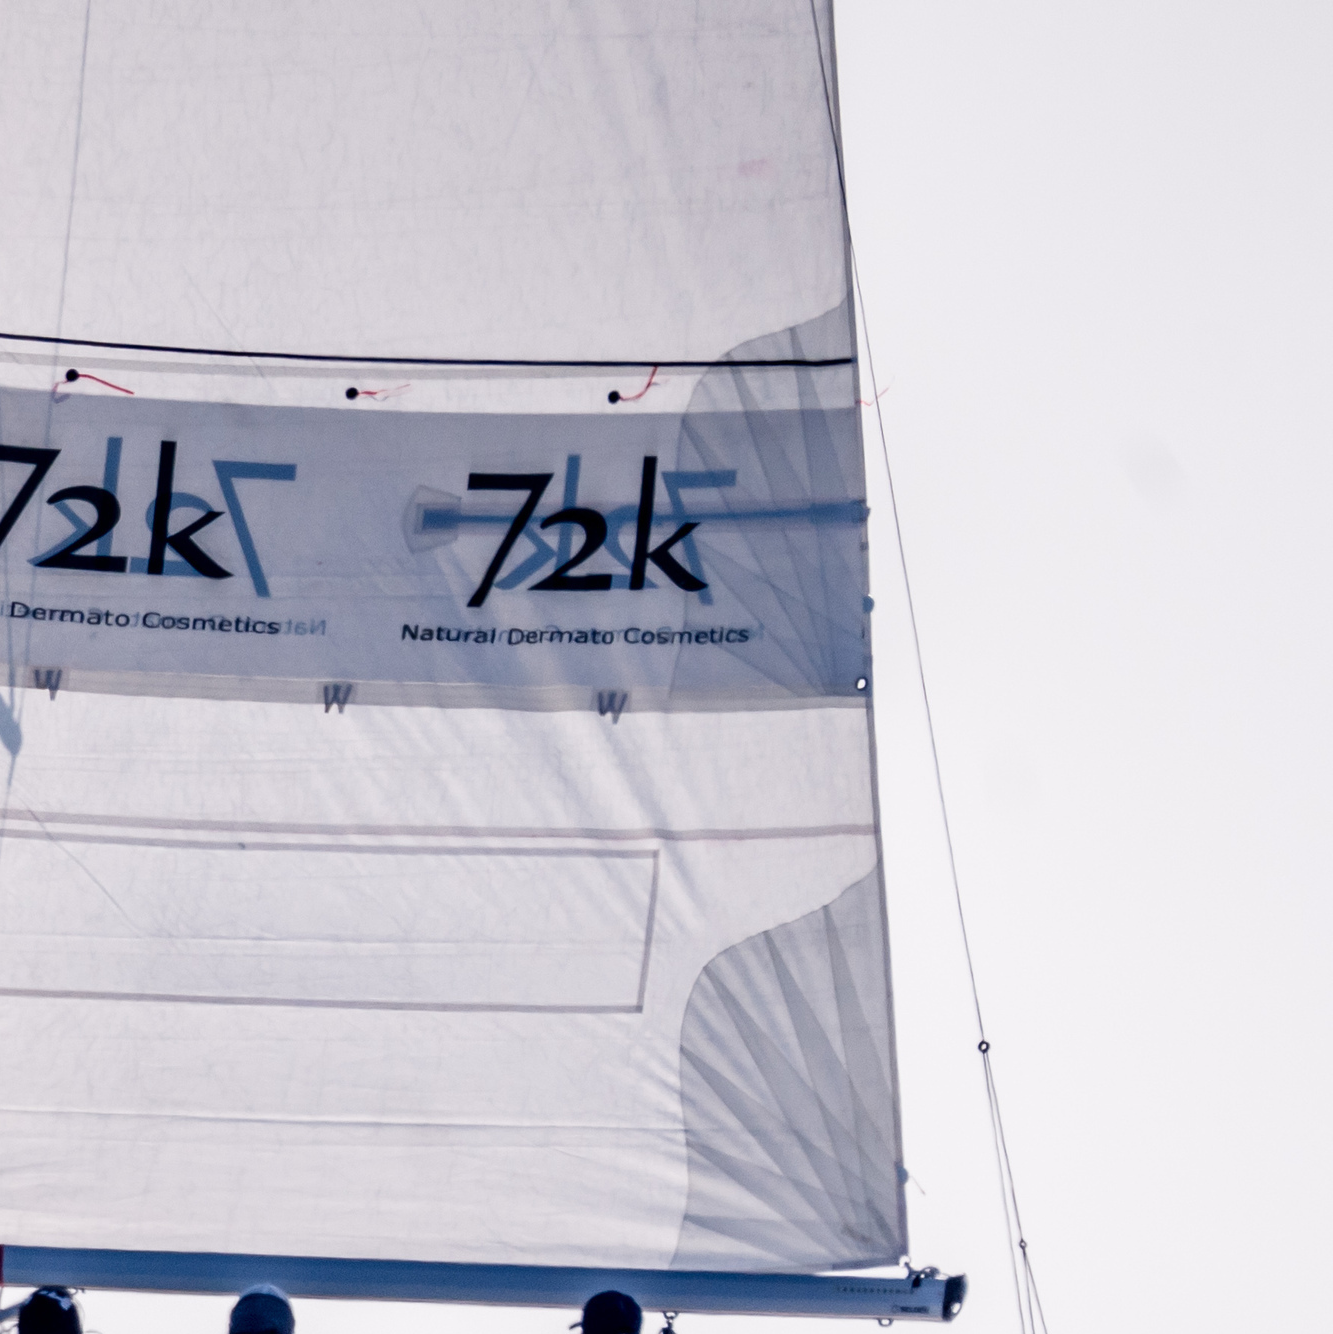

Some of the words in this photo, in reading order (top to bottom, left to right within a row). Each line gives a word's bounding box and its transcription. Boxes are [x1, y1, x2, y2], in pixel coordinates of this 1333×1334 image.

[466, 455, 709, 608] 72k
[10, 601, 131, 628] Dermato
[141, 609, 281, 636] Cosmetics
[401, 623, 496, 643] Natural
[506, 626, 615, 646] Dermato
[623, 626, 750, 645] Cosmetics
